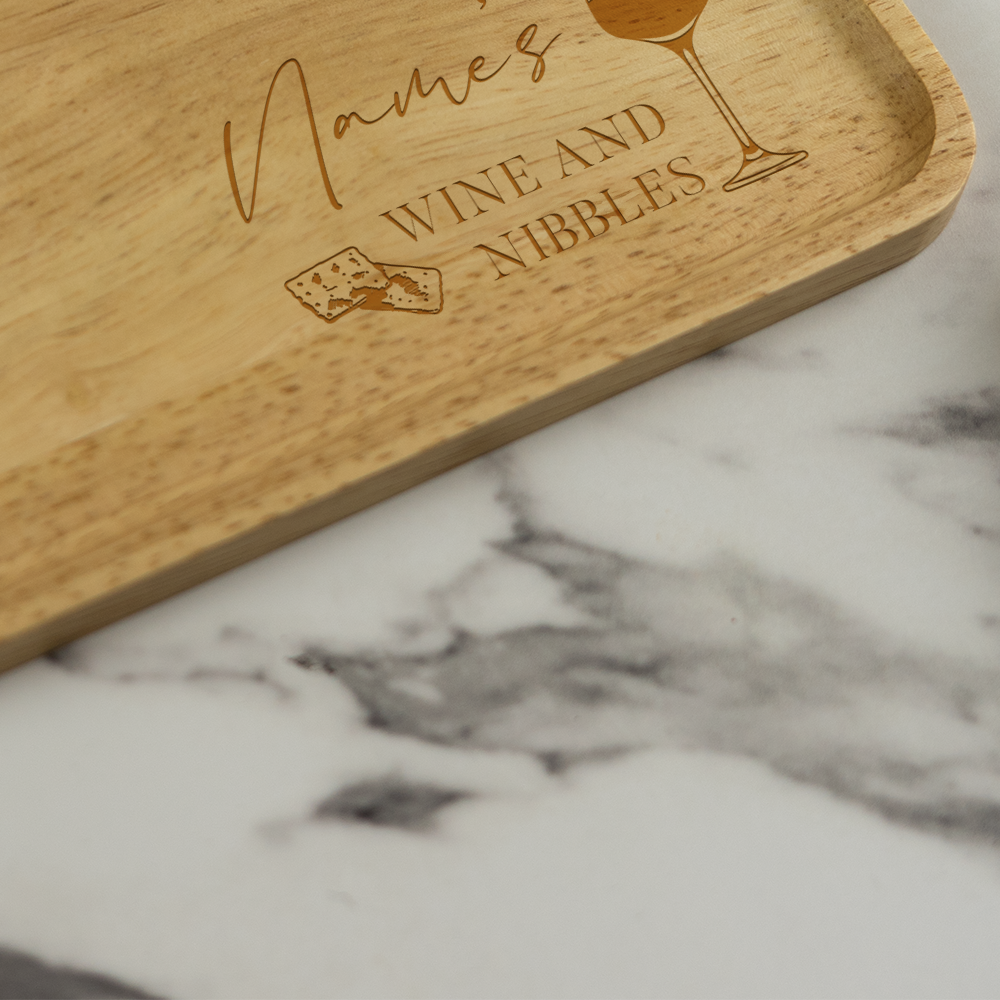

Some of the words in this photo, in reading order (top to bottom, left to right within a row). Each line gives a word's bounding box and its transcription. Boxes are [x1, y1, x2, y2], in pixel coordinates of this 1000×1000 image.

[378, 155, 544, 242] WINE
[554, 103, 667, 178] AND
[474, 156, 706, 282] NIBBLES
